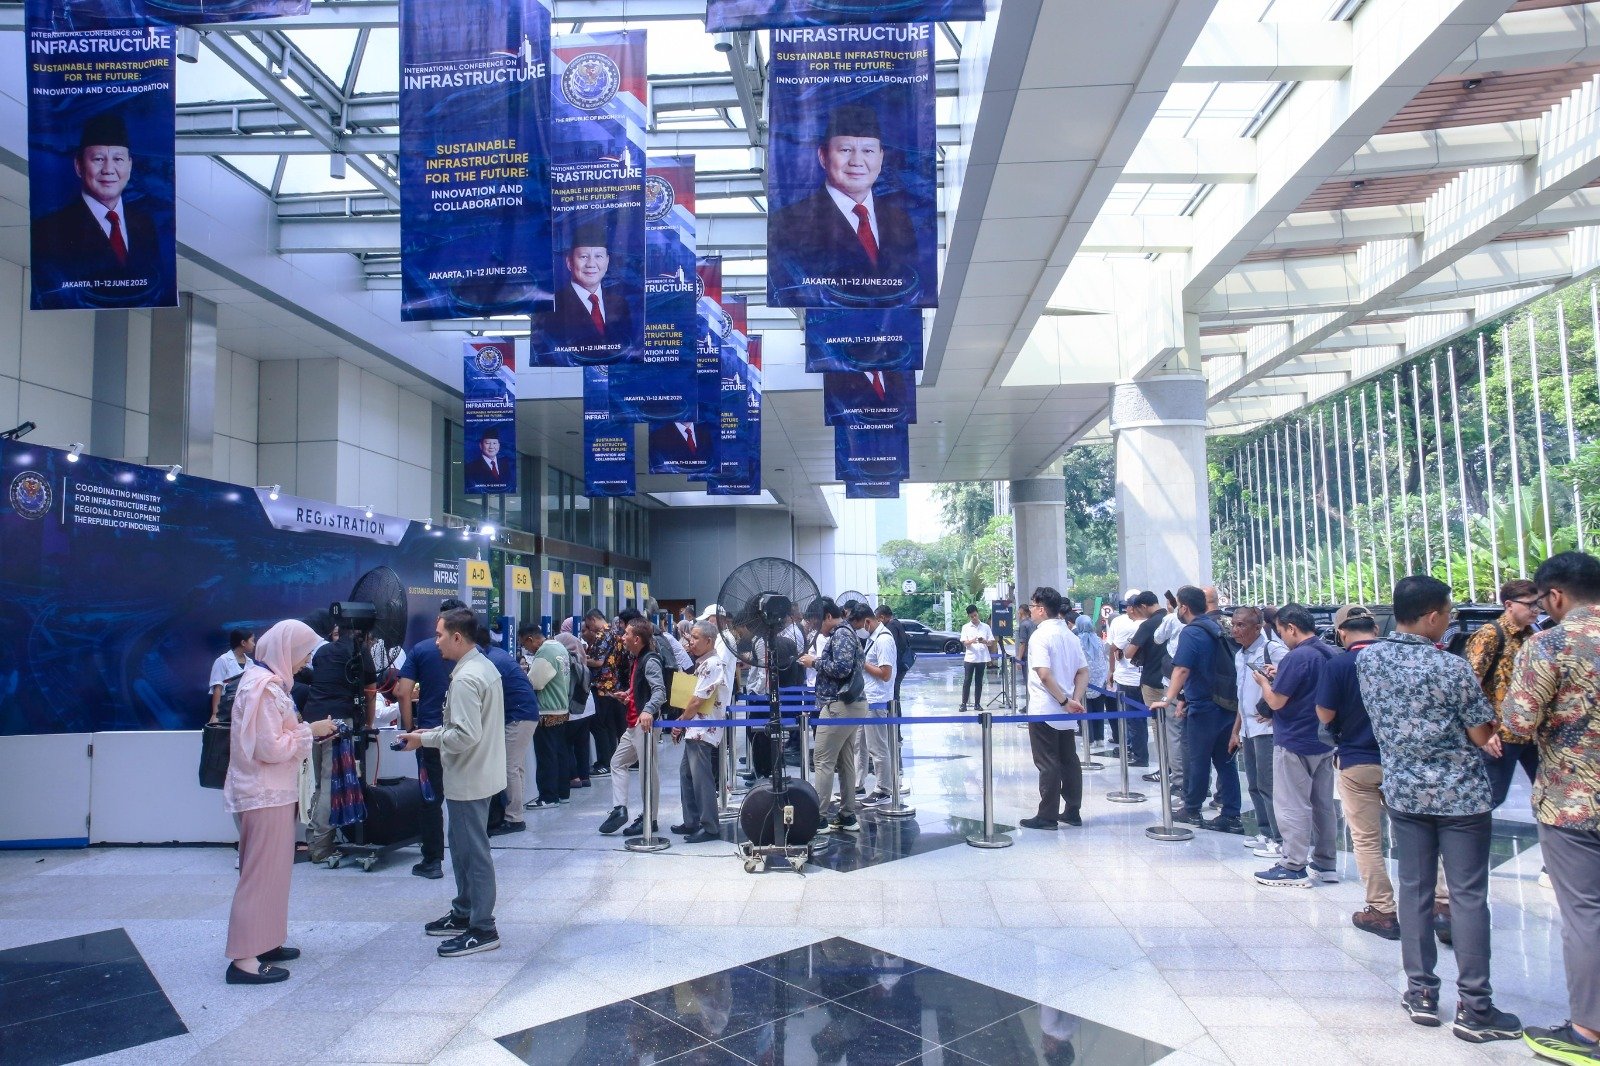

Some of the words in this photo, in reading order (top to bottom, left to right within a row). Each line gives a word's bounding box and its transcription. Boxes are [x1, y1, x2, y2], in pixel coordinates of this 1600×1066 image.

[775, 25, 929, 43] INFRASTRUCTURE
[31, 35, 170, 54] INFRASTRUCTURE
[776, 52, 841, 60] SUSTAINABLE
[845, 49, 928, 60] INFRASTRUCTURE
[33, 63, 92, 72] SUSTAINABLE
[96, 59, 169, 70] INFRASTRUCTURE
[404, 65, 457, 74] INTERNATIONAL
[459, 60, 503, 70] CONFERENCE
[404, 63, 545, 90] INFRASTRUCTURE
[855, 74, 929, 84] COLLABORATION
[34, 87, 83, 96] INNOVATION
[106, 83, 169, 93] COLLABORATION
[436, 139, 516, 155] SUSTAINABLE
[426, 153, 528, 169] INFRASTRUCTURE
[426, 174, 450, 184] FOR
[455, 172, 476, 182] THE
[480, 168, 529, 179] FUTURE:
[432, 186, 496, 199] INNOVATION
[500, 185, 523, 194] AND
[584, 185, 641, 193] INFRASTRUCTURE
[434, 197, 523, 211] COLLABORATION
[591, 202, 640, 210] COLLABORATION
[428, 271, 465, 280] JAKARTA,
[466, 269, 484, 277] 11-12
[486, 268, 506, 276] JUNE
[507, 266, 527, 274] 2025
[802, 278, 839, 286] JAKARTA,
[76, 483, 130, 498] COORDINATING
[132, 492, 161, 503] MINISTRY
[75, 494, 90, 503] FOR
[91, 496, 147, 511] INFRASTRUCTURE
[148, 504, 161, 513] AND
[74, 505, 111, 516] REGIONAL
[113, 509, 160, 522] DEVELOPMENT
[74, 515, 87, 524] THE
[87, 516, 118, 527] REPUBLIC
[128, 522, 160, 532] INDONESIA
[296, 507, 385, 535] REGISTRATION
[473, 569, 485, 580] A-D
[517, 574, 527, 584] E-G
